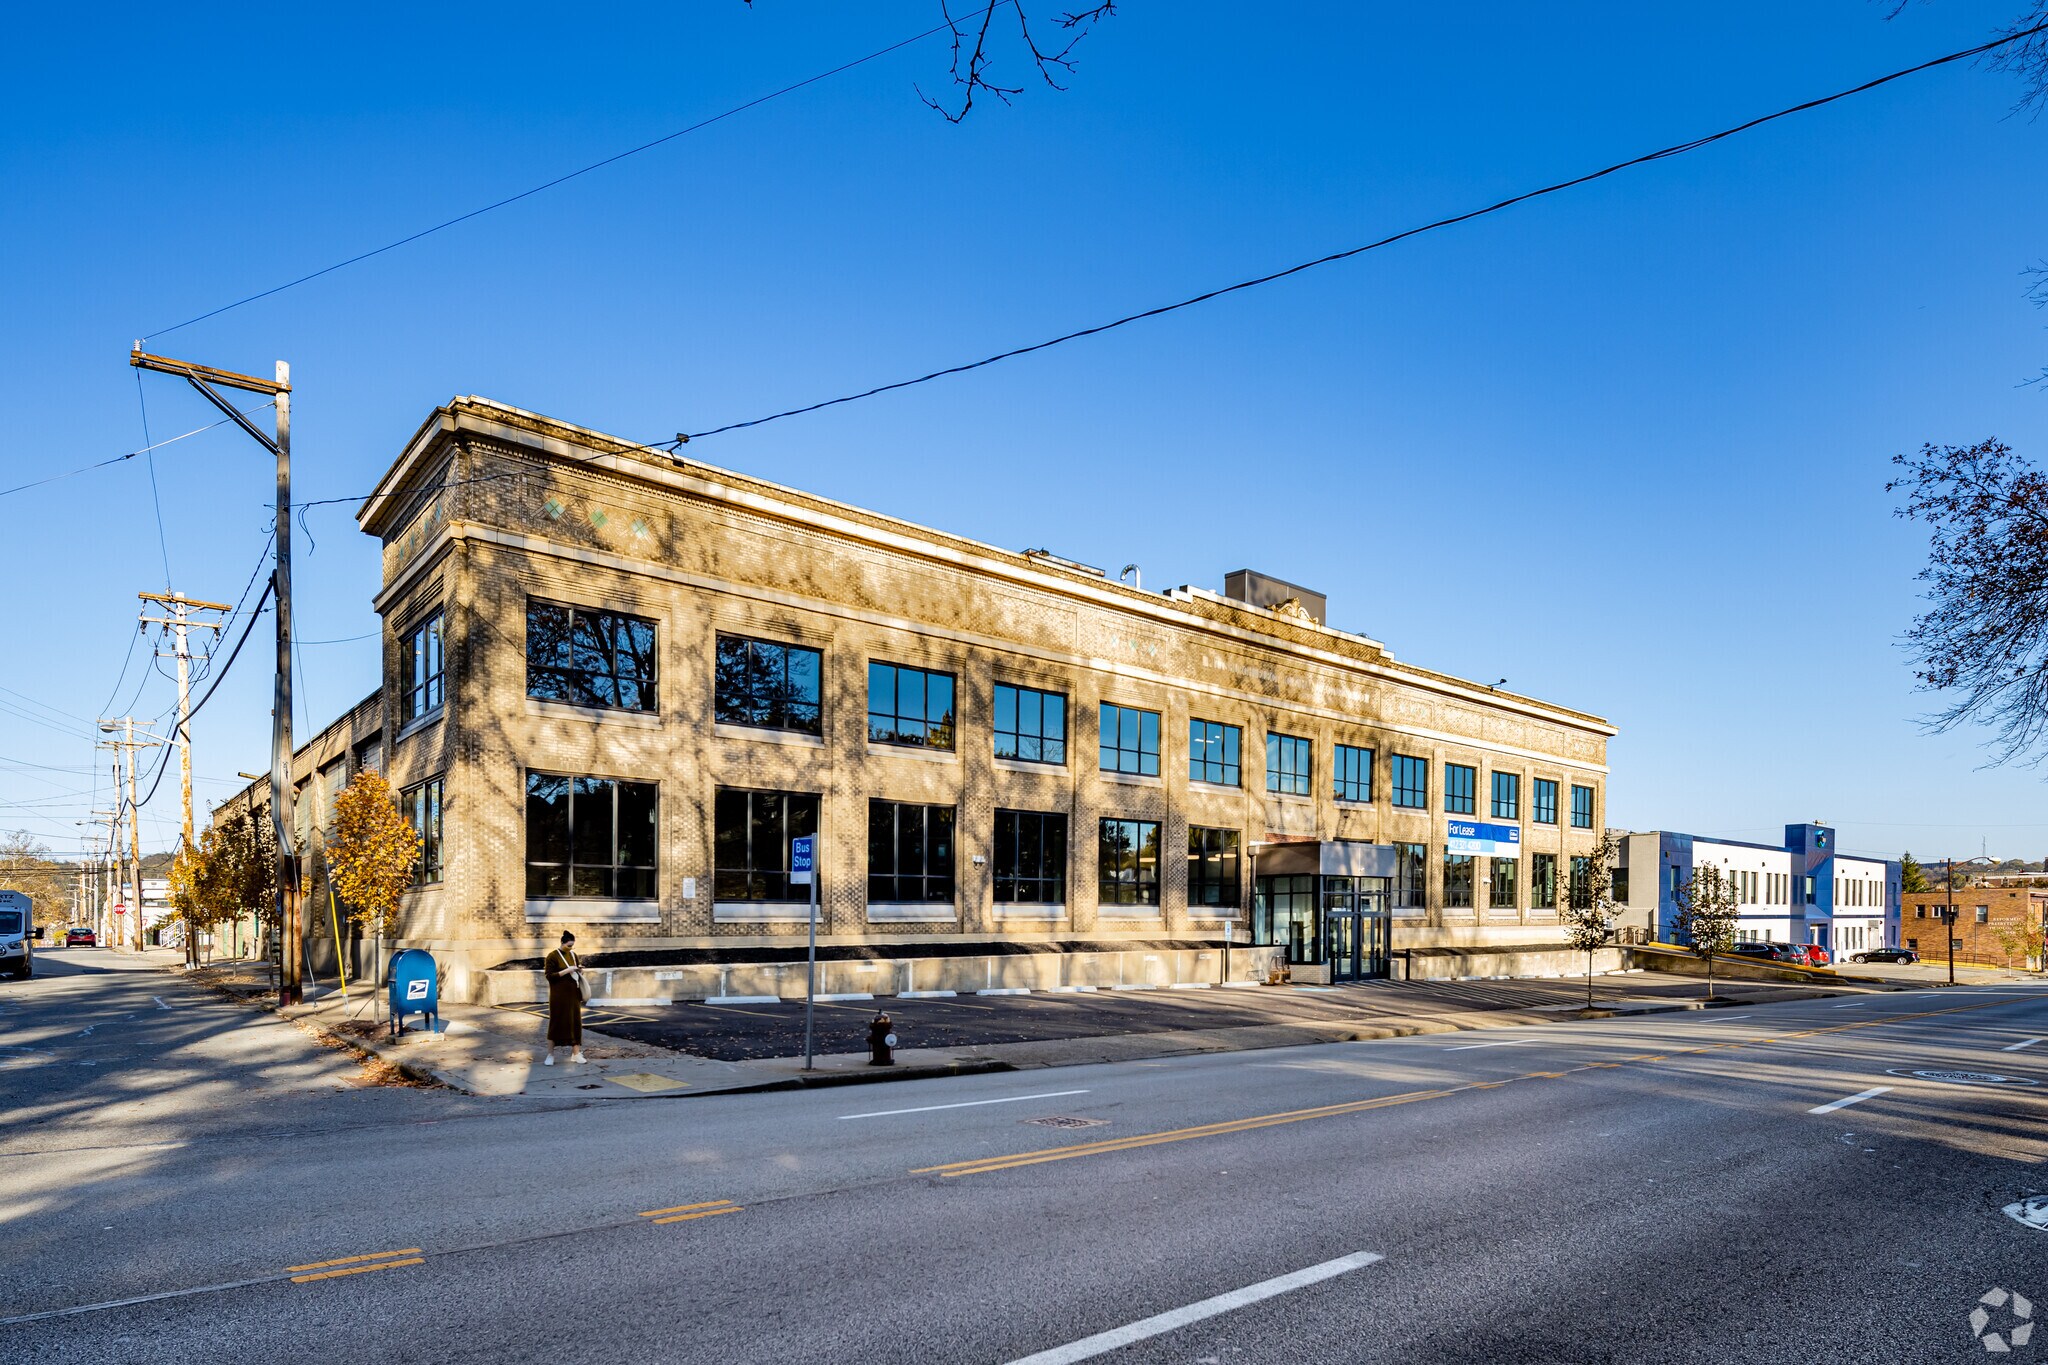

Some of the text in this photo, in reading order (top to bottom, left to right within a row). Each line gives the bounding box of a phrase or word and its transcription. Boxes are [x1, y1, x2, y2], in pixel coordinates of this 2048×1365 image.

[1449, 823, 1475, 836] For Lease
[796, 843, 810, 853] Bus
[794, 856, 811, 868] Stop
